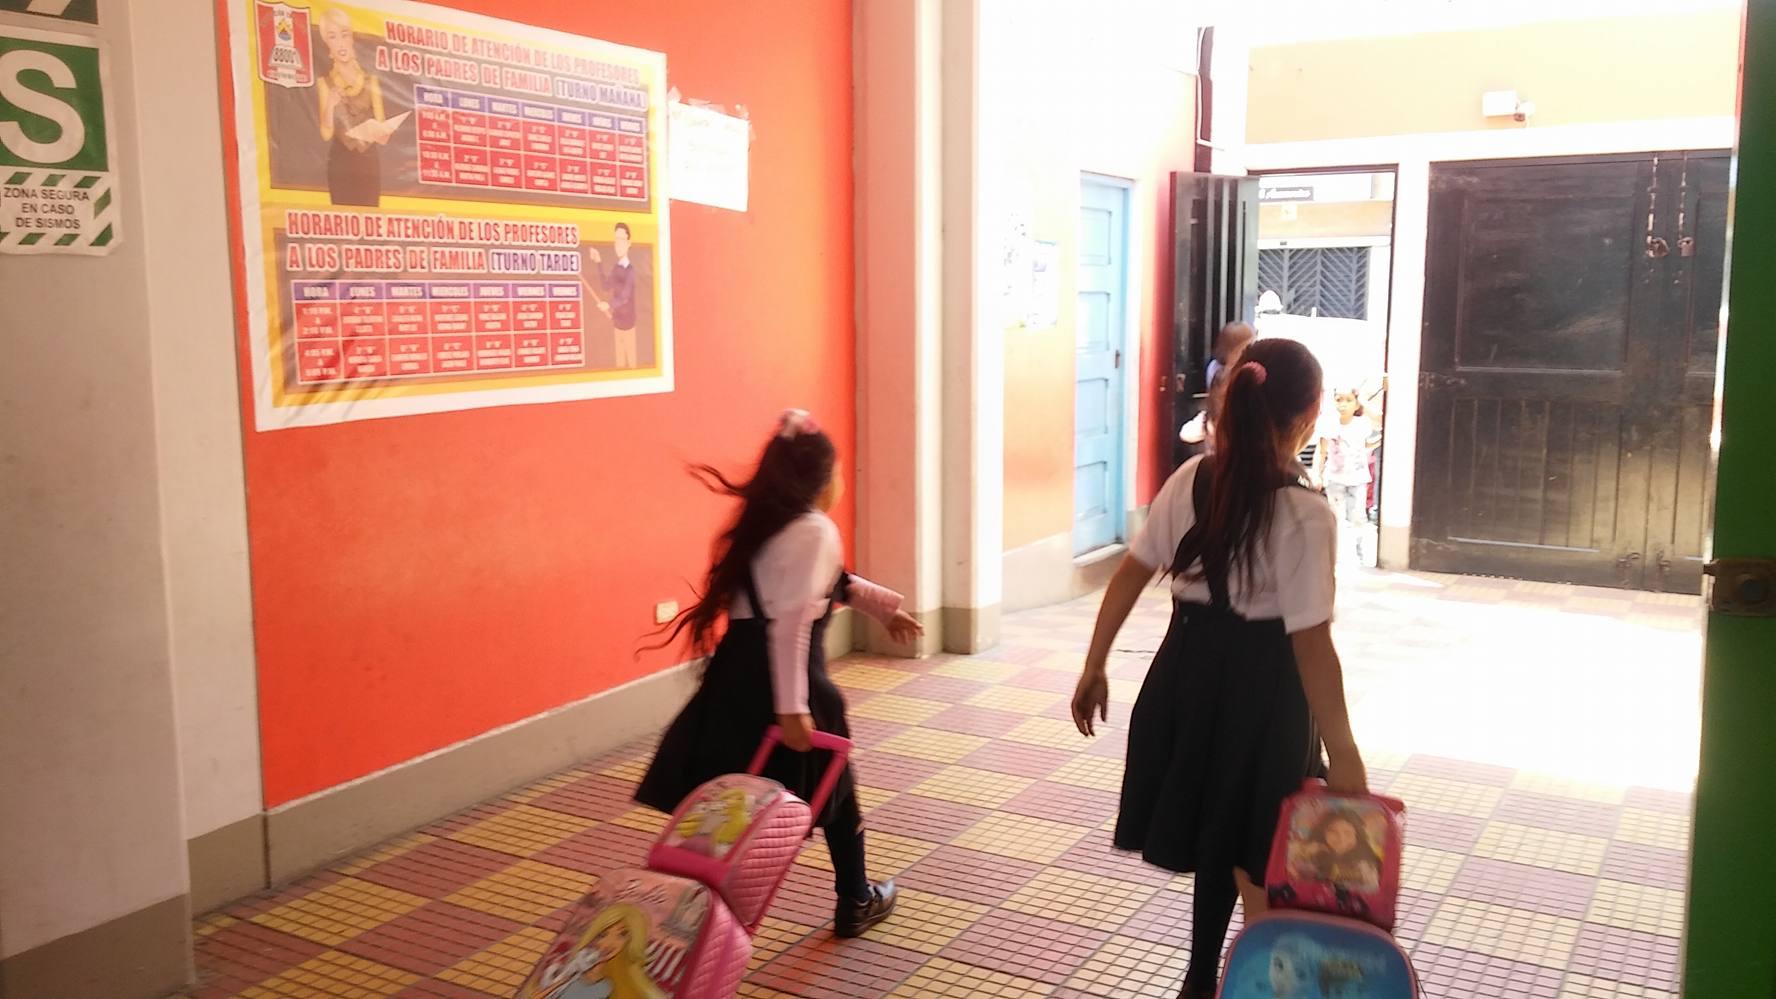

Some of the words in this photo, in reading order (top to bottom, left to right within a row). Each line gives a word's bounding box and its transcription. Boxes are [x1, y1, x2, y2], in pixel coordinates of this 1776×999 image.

[385, 21, 449, 50] HORARIO
[453, 33, 469, 54] DE
[471, 38, 531, 65] ATENCIÓN
[535, 50, 549, 68] DE
[551, 54, 571, 73] LOS
[574, 58, 641, 86] PROFESORES
[377, 49, 389, 70] A
[394, 51, 420, 74] LOS
[427, 56, 477, 82] PADRES
[483, 65, 499, 86] DE
[504, 69, 550, 94] FAMILIA
[0, 49, 85, 164] S
[3, 187, 39, 199] ZONA
[41, 189, 90, 202] SEGURA
[21, 202, 38, 214] EN
[41, 204, 75, 216] CASO
[15, 217, 32, 228] DE
[35, 218, 81, 230] SISMOS
[288, 212, 360, 237] HORARIO
[365, 216, 384, 238] DE
[386, 216, 455, 240] ATENCIÓN
[459, 220, 475, 241] DE
[478, 222, 500, 242] LOS
[503, 223, 578, 245] PROFESORES
[288, 246, 300, 268] A
[307, 247, 337, 269] LOS
[344, 247, 401, 270] PADRES
[408, 249, 426, 270] DE
[433, 250, 485, 270] FAMILIA
